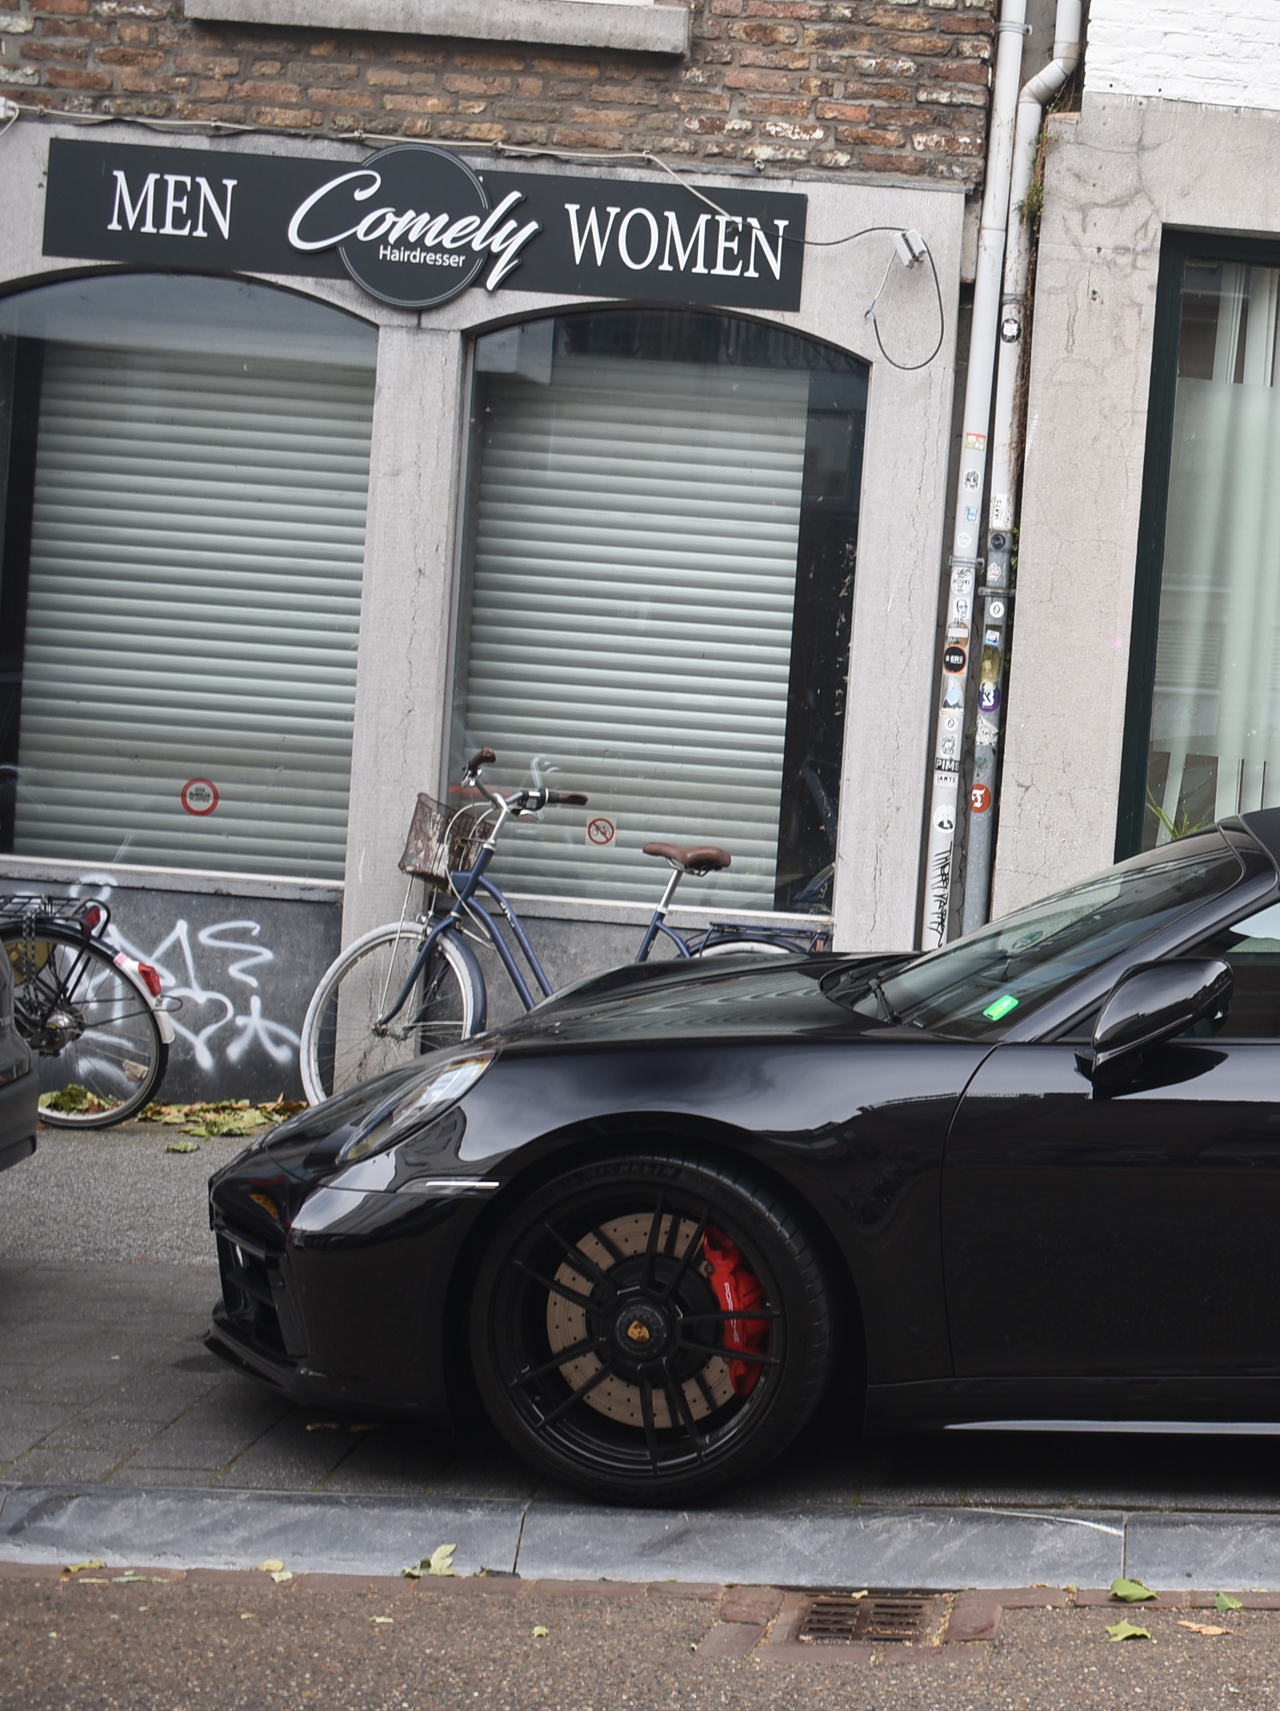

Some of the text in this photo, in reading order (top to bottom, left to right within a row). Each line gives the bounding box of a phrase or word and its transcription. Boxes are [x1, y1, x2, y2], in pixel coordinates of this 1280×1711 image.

[107, 169, 238, 240] MEN
[288, 169, 540, 291] Comely
[563, 203, 790, 281] WOMEN
[379, 244, 466, 269] Hairdresser
[935, 759, 960, 772] PIMS
[582, 1160, 676, 1180] MICHELIN
